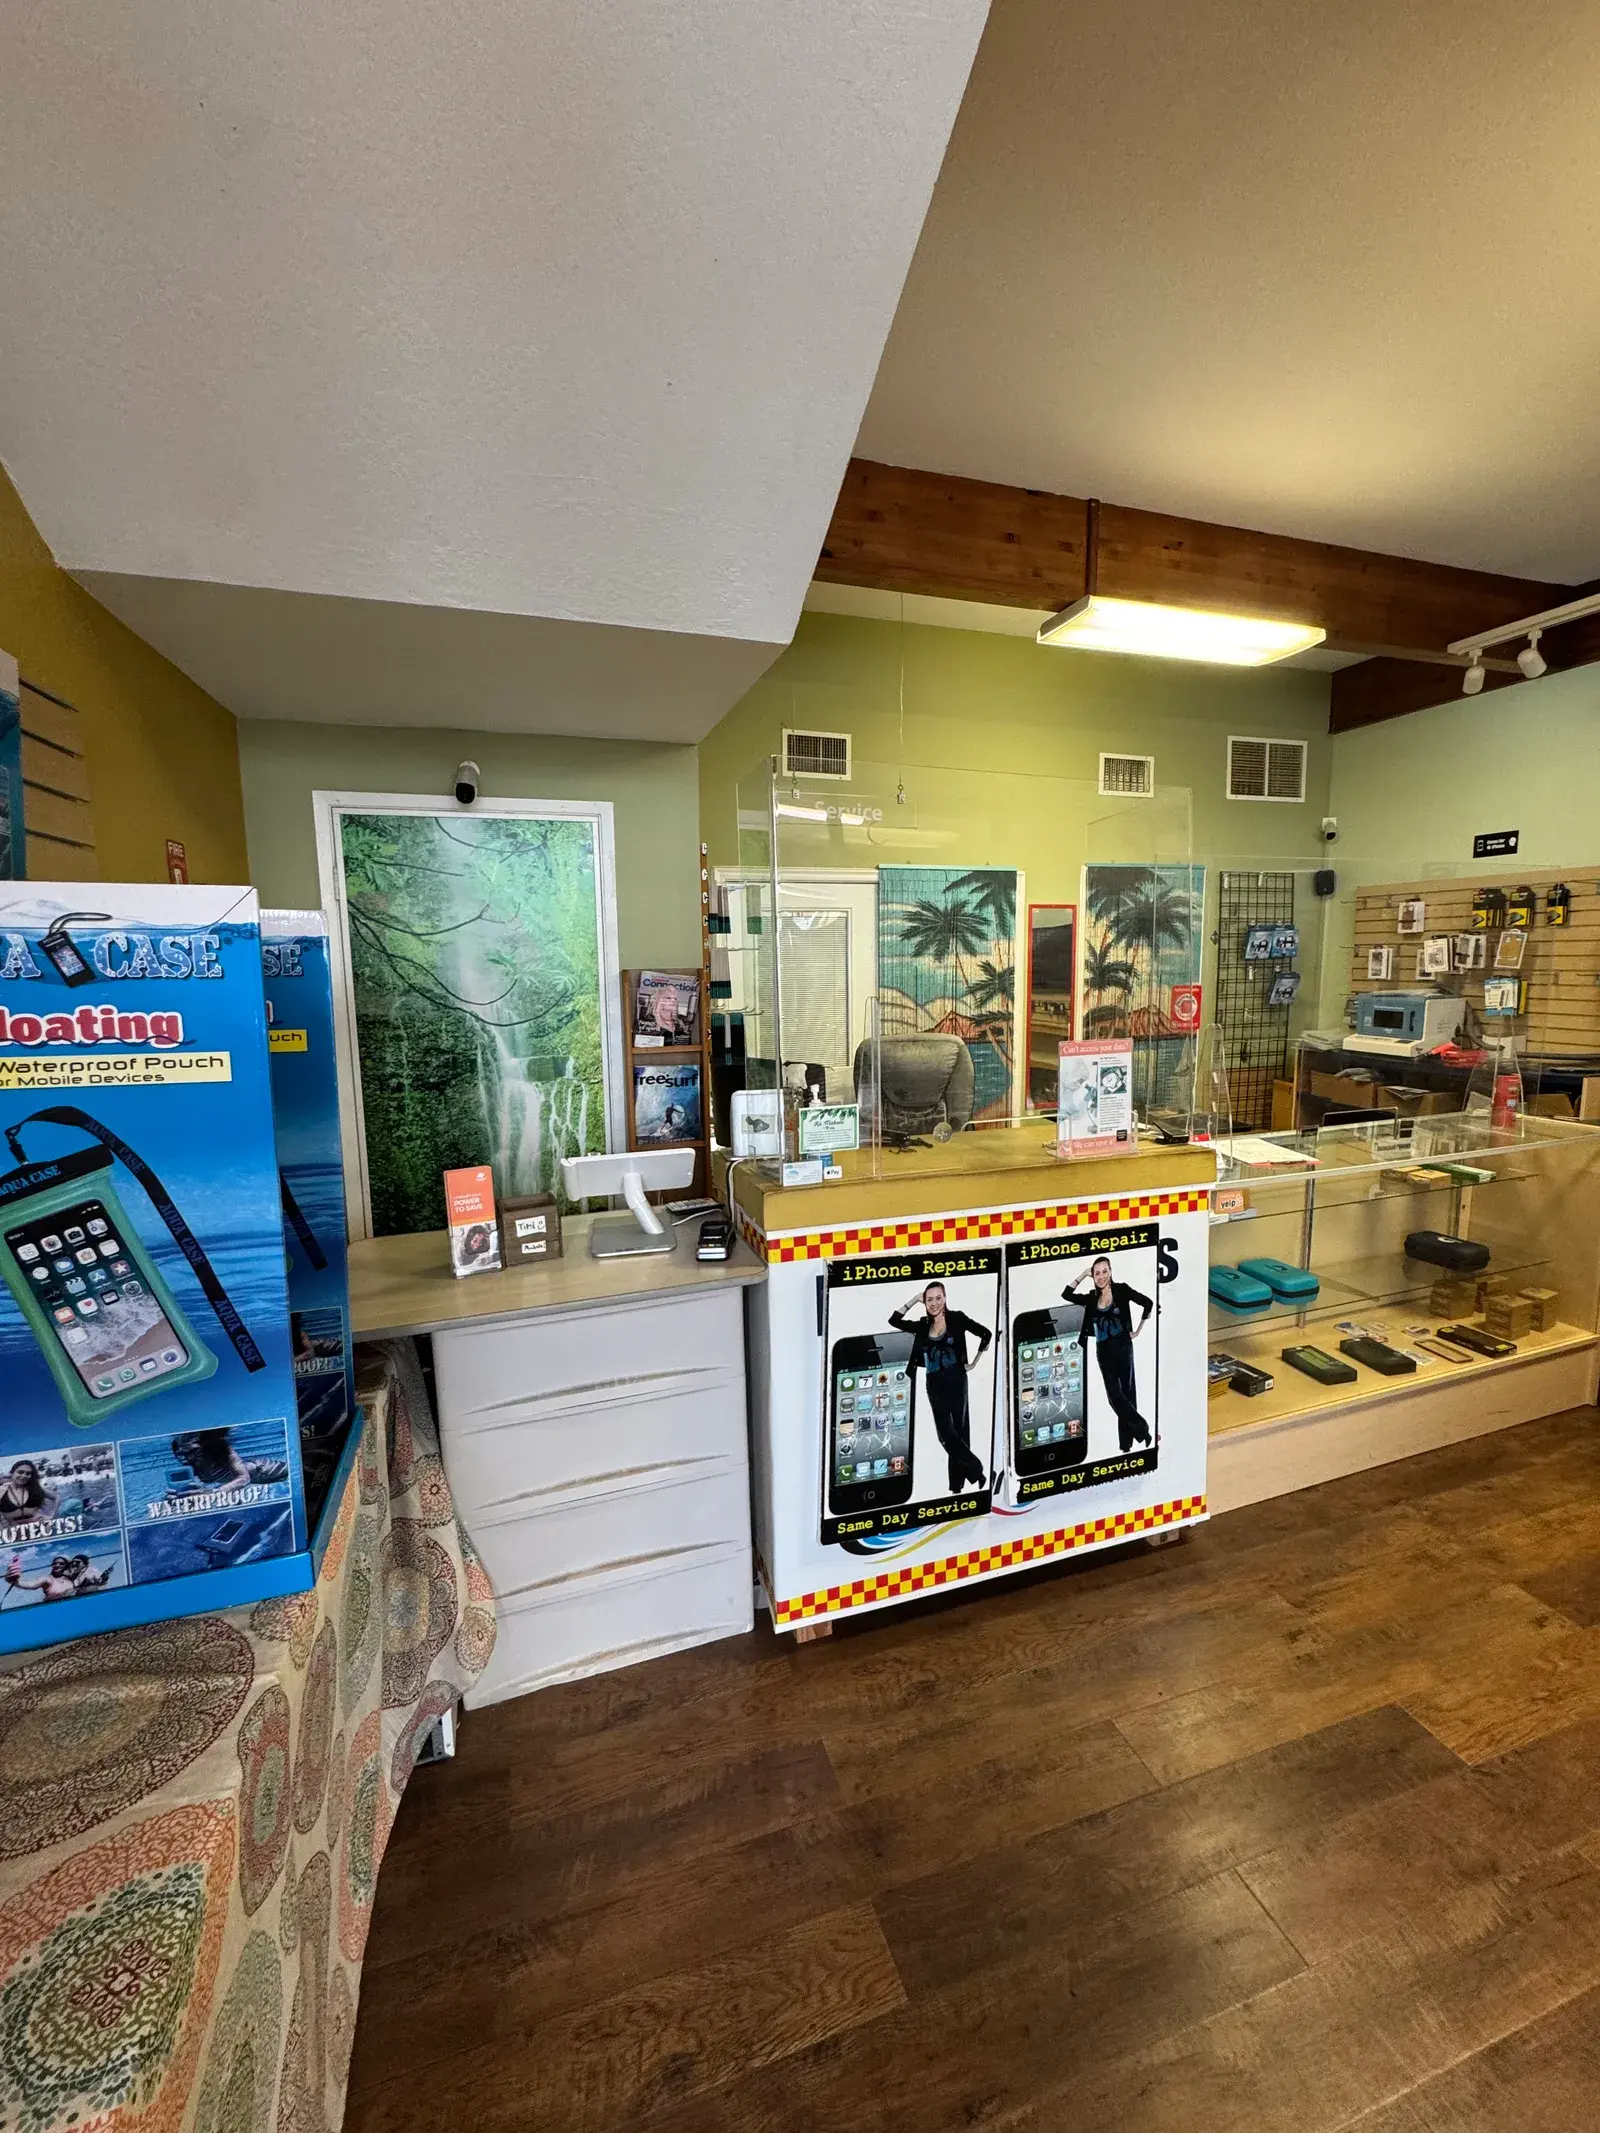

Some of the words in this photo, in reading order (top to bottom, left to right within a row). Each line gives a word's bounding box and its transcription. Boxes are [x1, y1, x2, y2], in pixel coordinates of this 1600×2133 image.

[814, 800, 884, 822] Service
[167, 841, 185, 858] FIRE
[94, 931, 224, 979] CASE
[145, 1055, 225, 1071] Pouch
[18, 1074, 83, 1087] Mobile
[89, 1071, 165, 1085] Devices
[29, 1165, 62, 1184] CASE
[453, 1197, 481, 1207] POWER
[454, 1205, 466, 1214] TO
[465, 1203, 484, 1212] SAVE
[1220, 1199, 1236, 1209] yelp
[1020, 1239, 1082, 1261] iPhone
[1089, 1231, 1149, 1253] Repair
[843, 1262, 912, 1282] iPhone
[922, 1256, 988, 1278] Repair
[1022, 1478, 1055, 1495] Same
[1060, 1471, 1086, 1490] Day
[1092, 1456, 1145, 1480] Service
[147, 1483, 271, 1519] WATERPROOF!
[836, 1519, 874, 1535] Same
[880, 1512, 910, 1531] Day
[917, 1500, 978, 1523] Service
